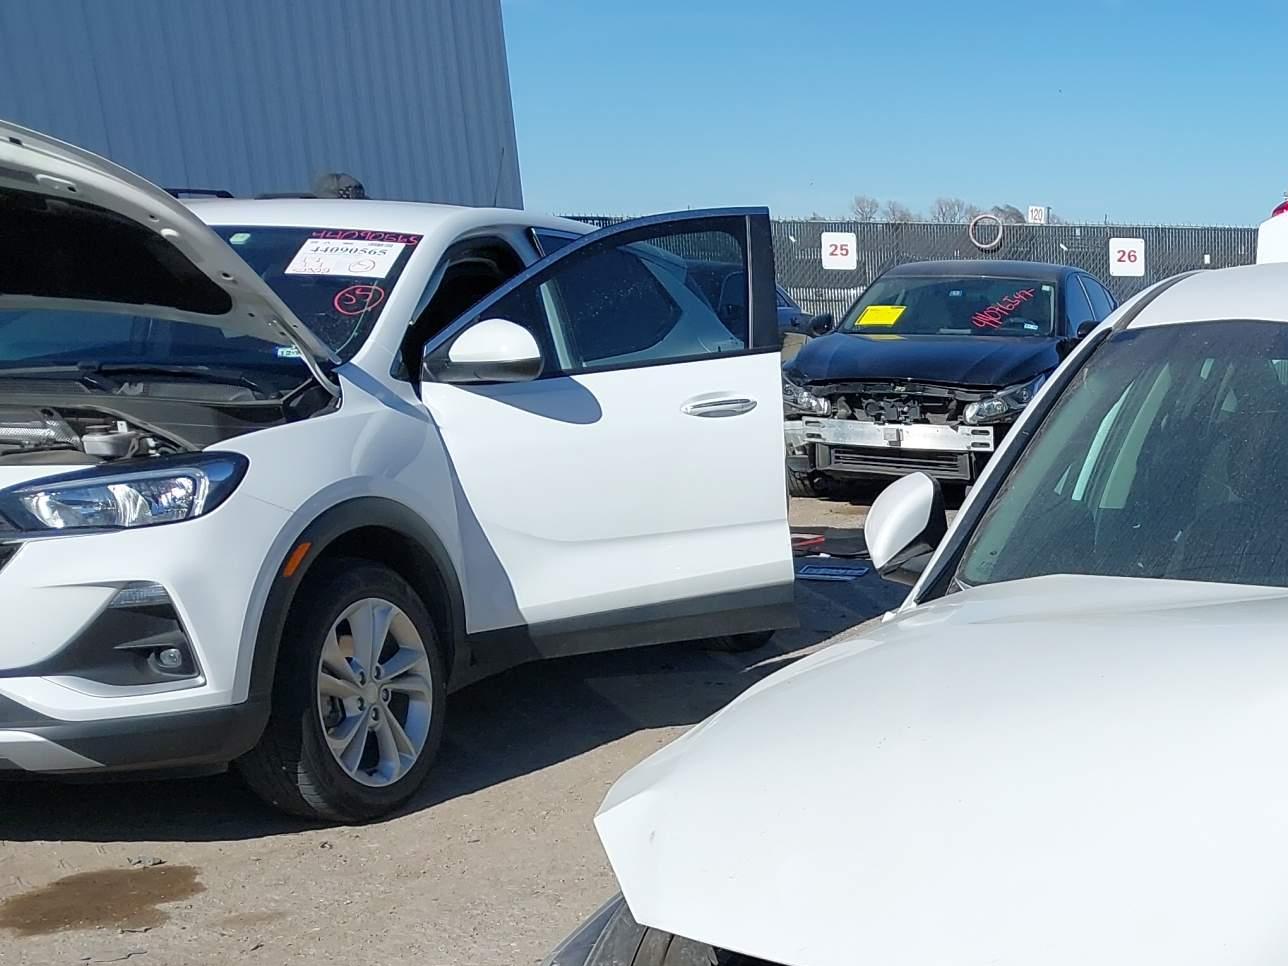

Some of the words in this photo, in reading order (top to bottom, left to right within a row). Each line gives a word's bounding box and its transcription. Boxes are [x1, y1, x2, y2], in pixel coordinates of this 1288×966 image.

[311, 245, 388, 256] 44090565
[829, 243, 849, 257] 25
[1116, 249, 1138, 263] 26
